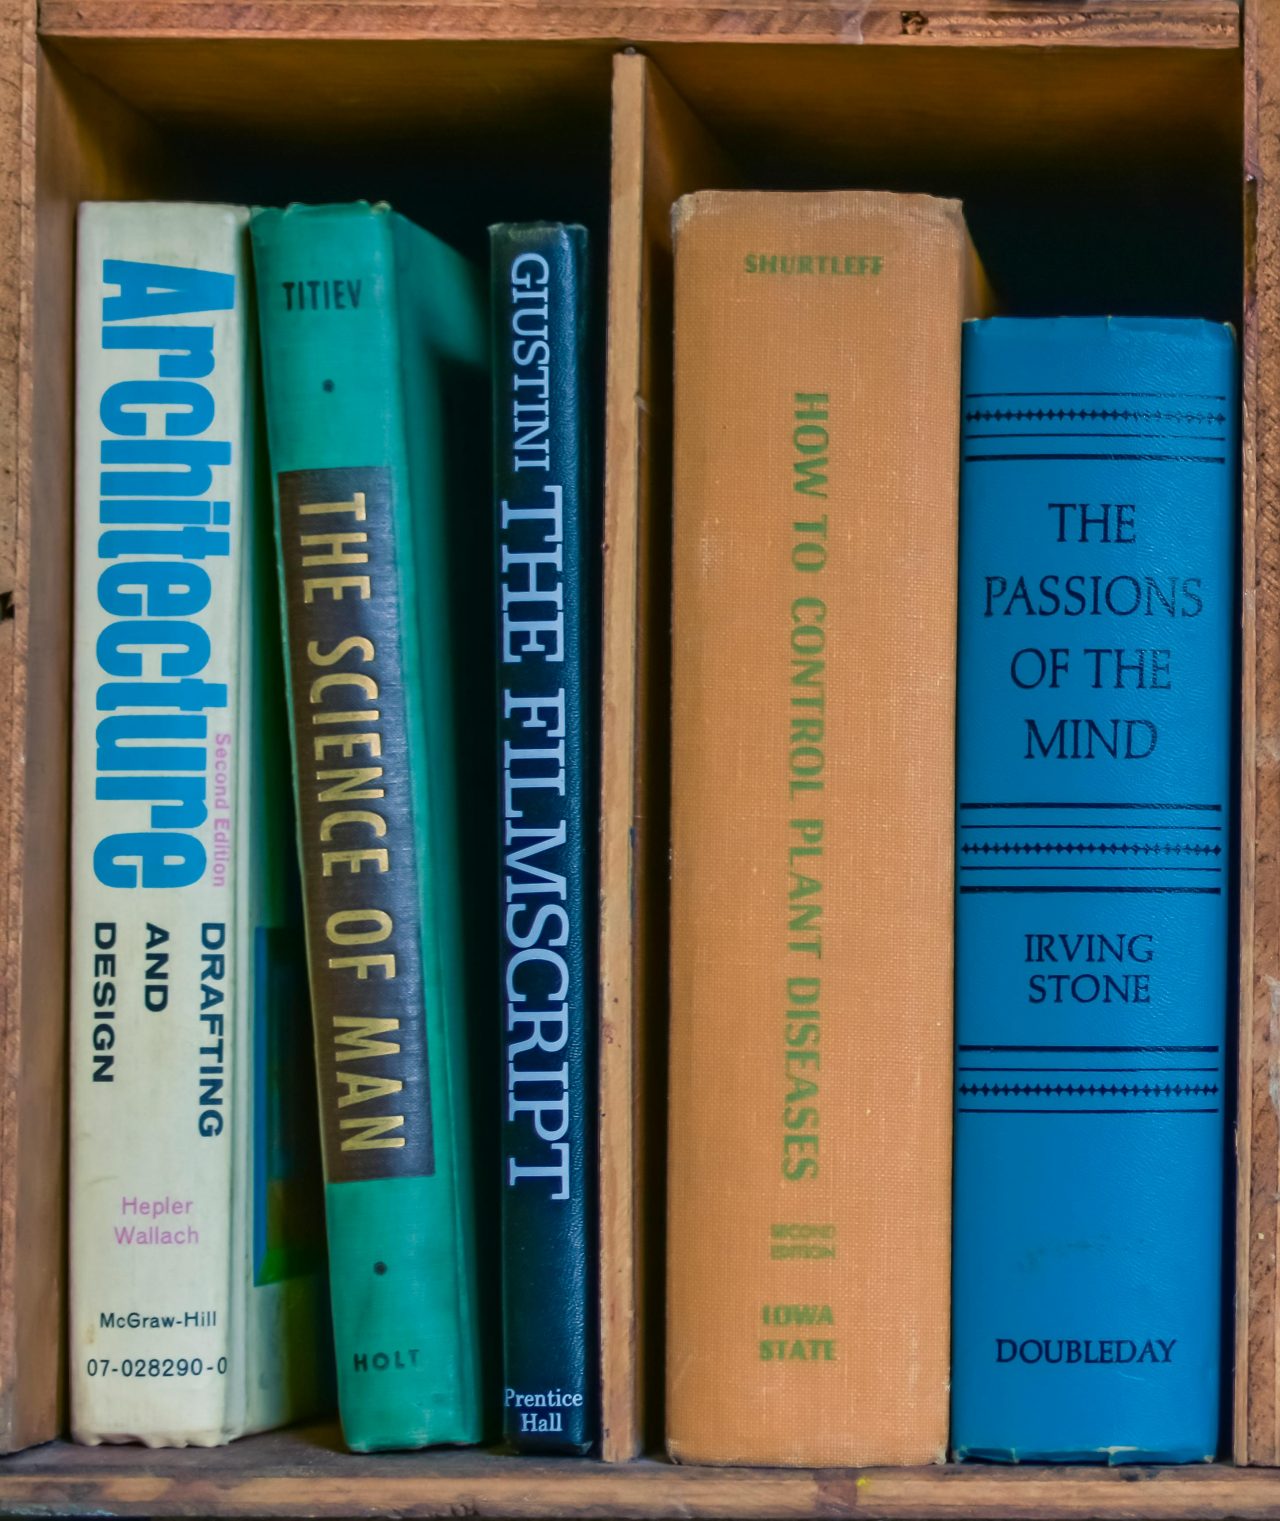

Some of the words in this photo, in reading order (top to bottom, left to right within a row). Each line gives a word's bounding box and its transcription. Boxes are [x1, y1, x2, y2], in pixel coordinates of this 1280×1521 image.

[744, 254, 884, 277] SHURTLEFF
[281, 280, 362, 311] TITIEV
[509, 253, 551, 473] GIUSTINI
[792, 393, 830, 499] HOW
[298, 492, 371, 604] THE
[790, 514, 828, 574] TO
[1048, 504, 1137, 543] THE
[93, 259, 235, 888] Architecture
[501, 485, 564, 664] THE
[983, 576, 1203, 618] PASSIONS
[1010, 648, 1069, 688] OF
[1083, 648, 1172, 690] THE
[788, 597, 828, 801] CONTROL
[306, 636, 389, 877] SCIENCE
[1024, 719, 1157, 759] MIND
[215, 733, 231, 809] Second
[212, 818, 230, 887] Edition
[787, 819, 825, 959] PLANT
[144, 922, 170, 1012] AND
[325, 908, 395, 980] OF
[503, 687, 570, 1201] FILMSCRIPT
[1024, 934, 1154, 964] IRVING
[92, 922, 117, 1083] DESIGN
[1029, 974, 1150, 1004] STONE
[198, 922, 226, 1137] DRAFTING
[332, 1015, 405, 1152] MAN
[781, 977, 821, 1182] DISEASES
[122, 1196, 193, 1220] Hepler
[114, 1226, 199, 1245] Wallach
[100, 1311, 216, 1328] McGraw-Hill
[762, 1305, 834, 1326] IOWA
[87, 1357, 228, 1377] 07-028290-0
[353, 1349, 419, 1373] HOLT
[759, 1340, 837, 1361] STATE
[995, 1339, 1177, 1364] DOUBLEDAY
[504, 1388, 583, 1407] Prentice
[521, 1412, 563, 1432] Hall
